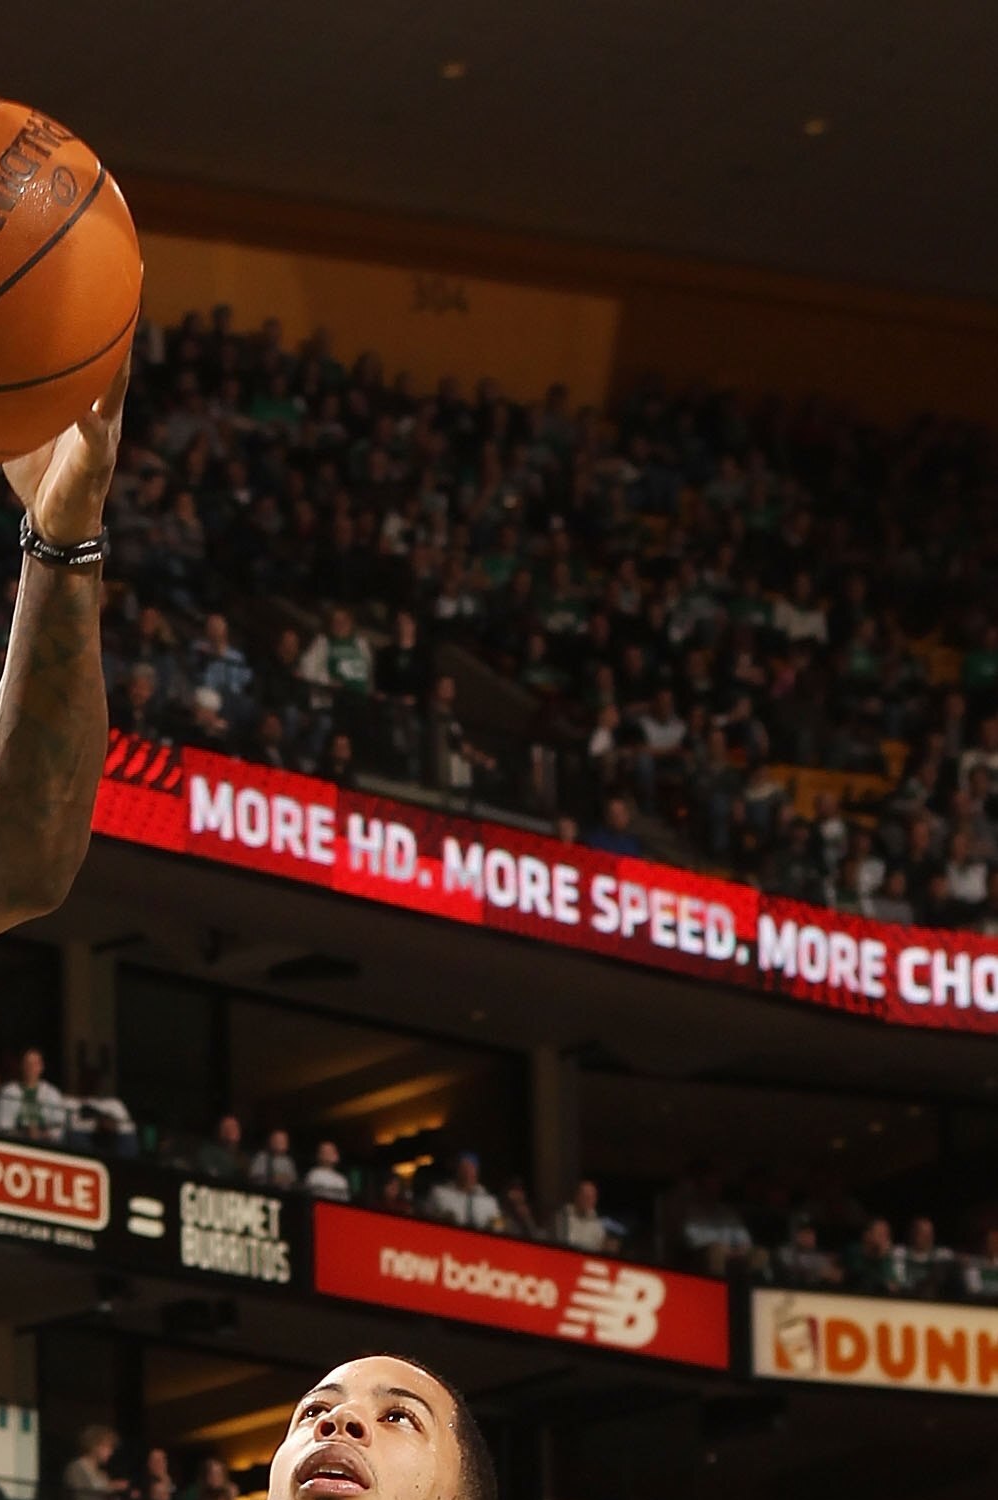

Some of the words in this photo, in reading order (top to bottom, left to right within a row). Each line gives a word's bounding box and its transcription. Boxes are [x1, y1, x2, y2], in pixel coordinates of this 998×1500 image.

[189, 774, 336, 866] MORE
[348, 813, 434, 889] HD.
[443, 836, 581, 924] MORE
[590, 873, 751, 966] SPEED.
[757, 914, 887, 998] MORE
[897, 945, 998, 1012] CHO
[180, 1181, 281, 1240] GOURMET
[180, 1225, 291, 1283] BURRITOS
[379, 1246, 439, 1285] new
[442, 1252, 559, 1309] balance
